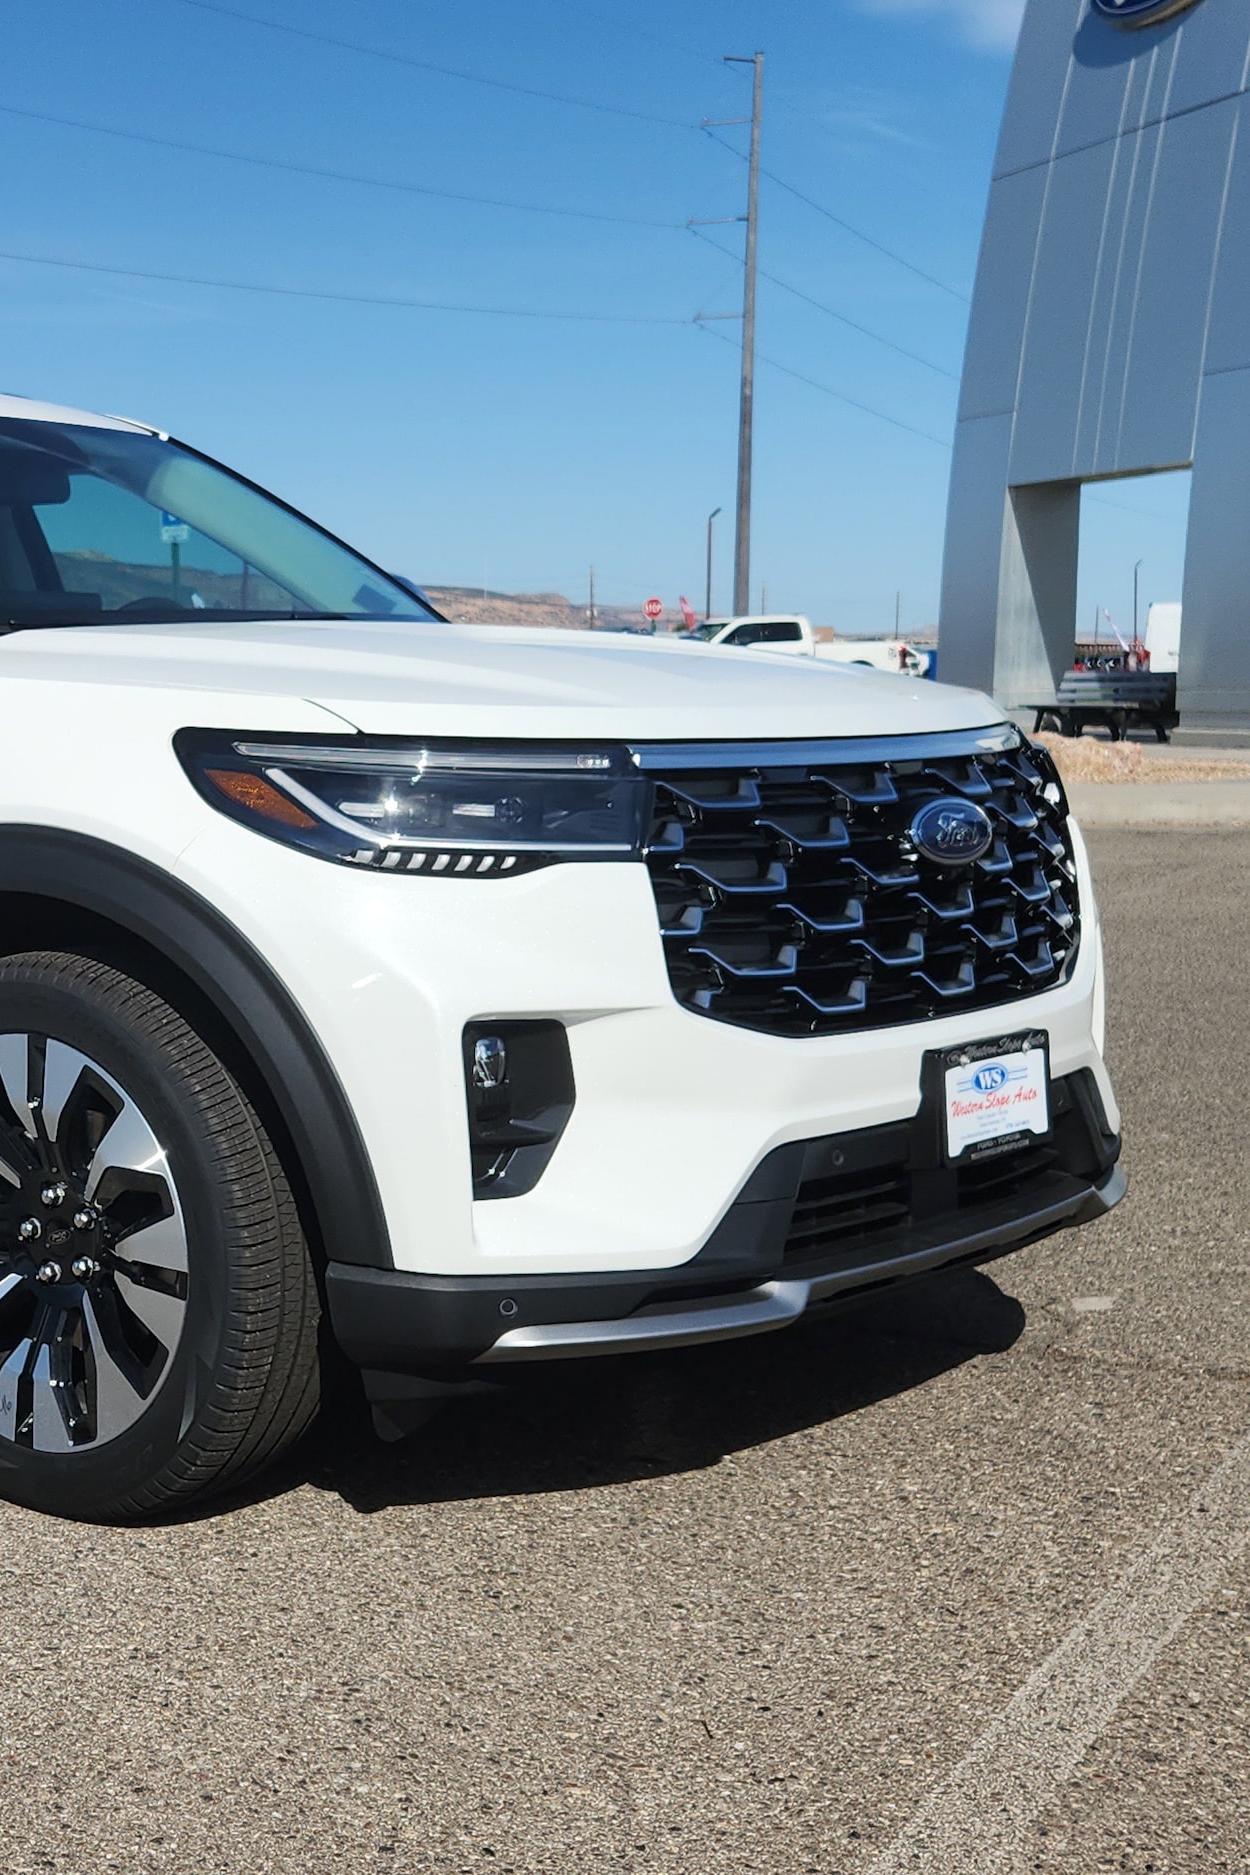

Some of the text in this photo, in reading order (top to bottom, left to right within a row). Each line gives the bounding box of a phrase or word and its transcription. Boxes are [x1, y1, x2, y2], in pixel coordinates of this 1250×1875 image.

[977, 1069, 1001, 1090] WS
[951, 1100, 983, 1118] Western
[985, 1091, 1011, 1110] Slope
[1012, 1086, 1038, 1105] Auto
